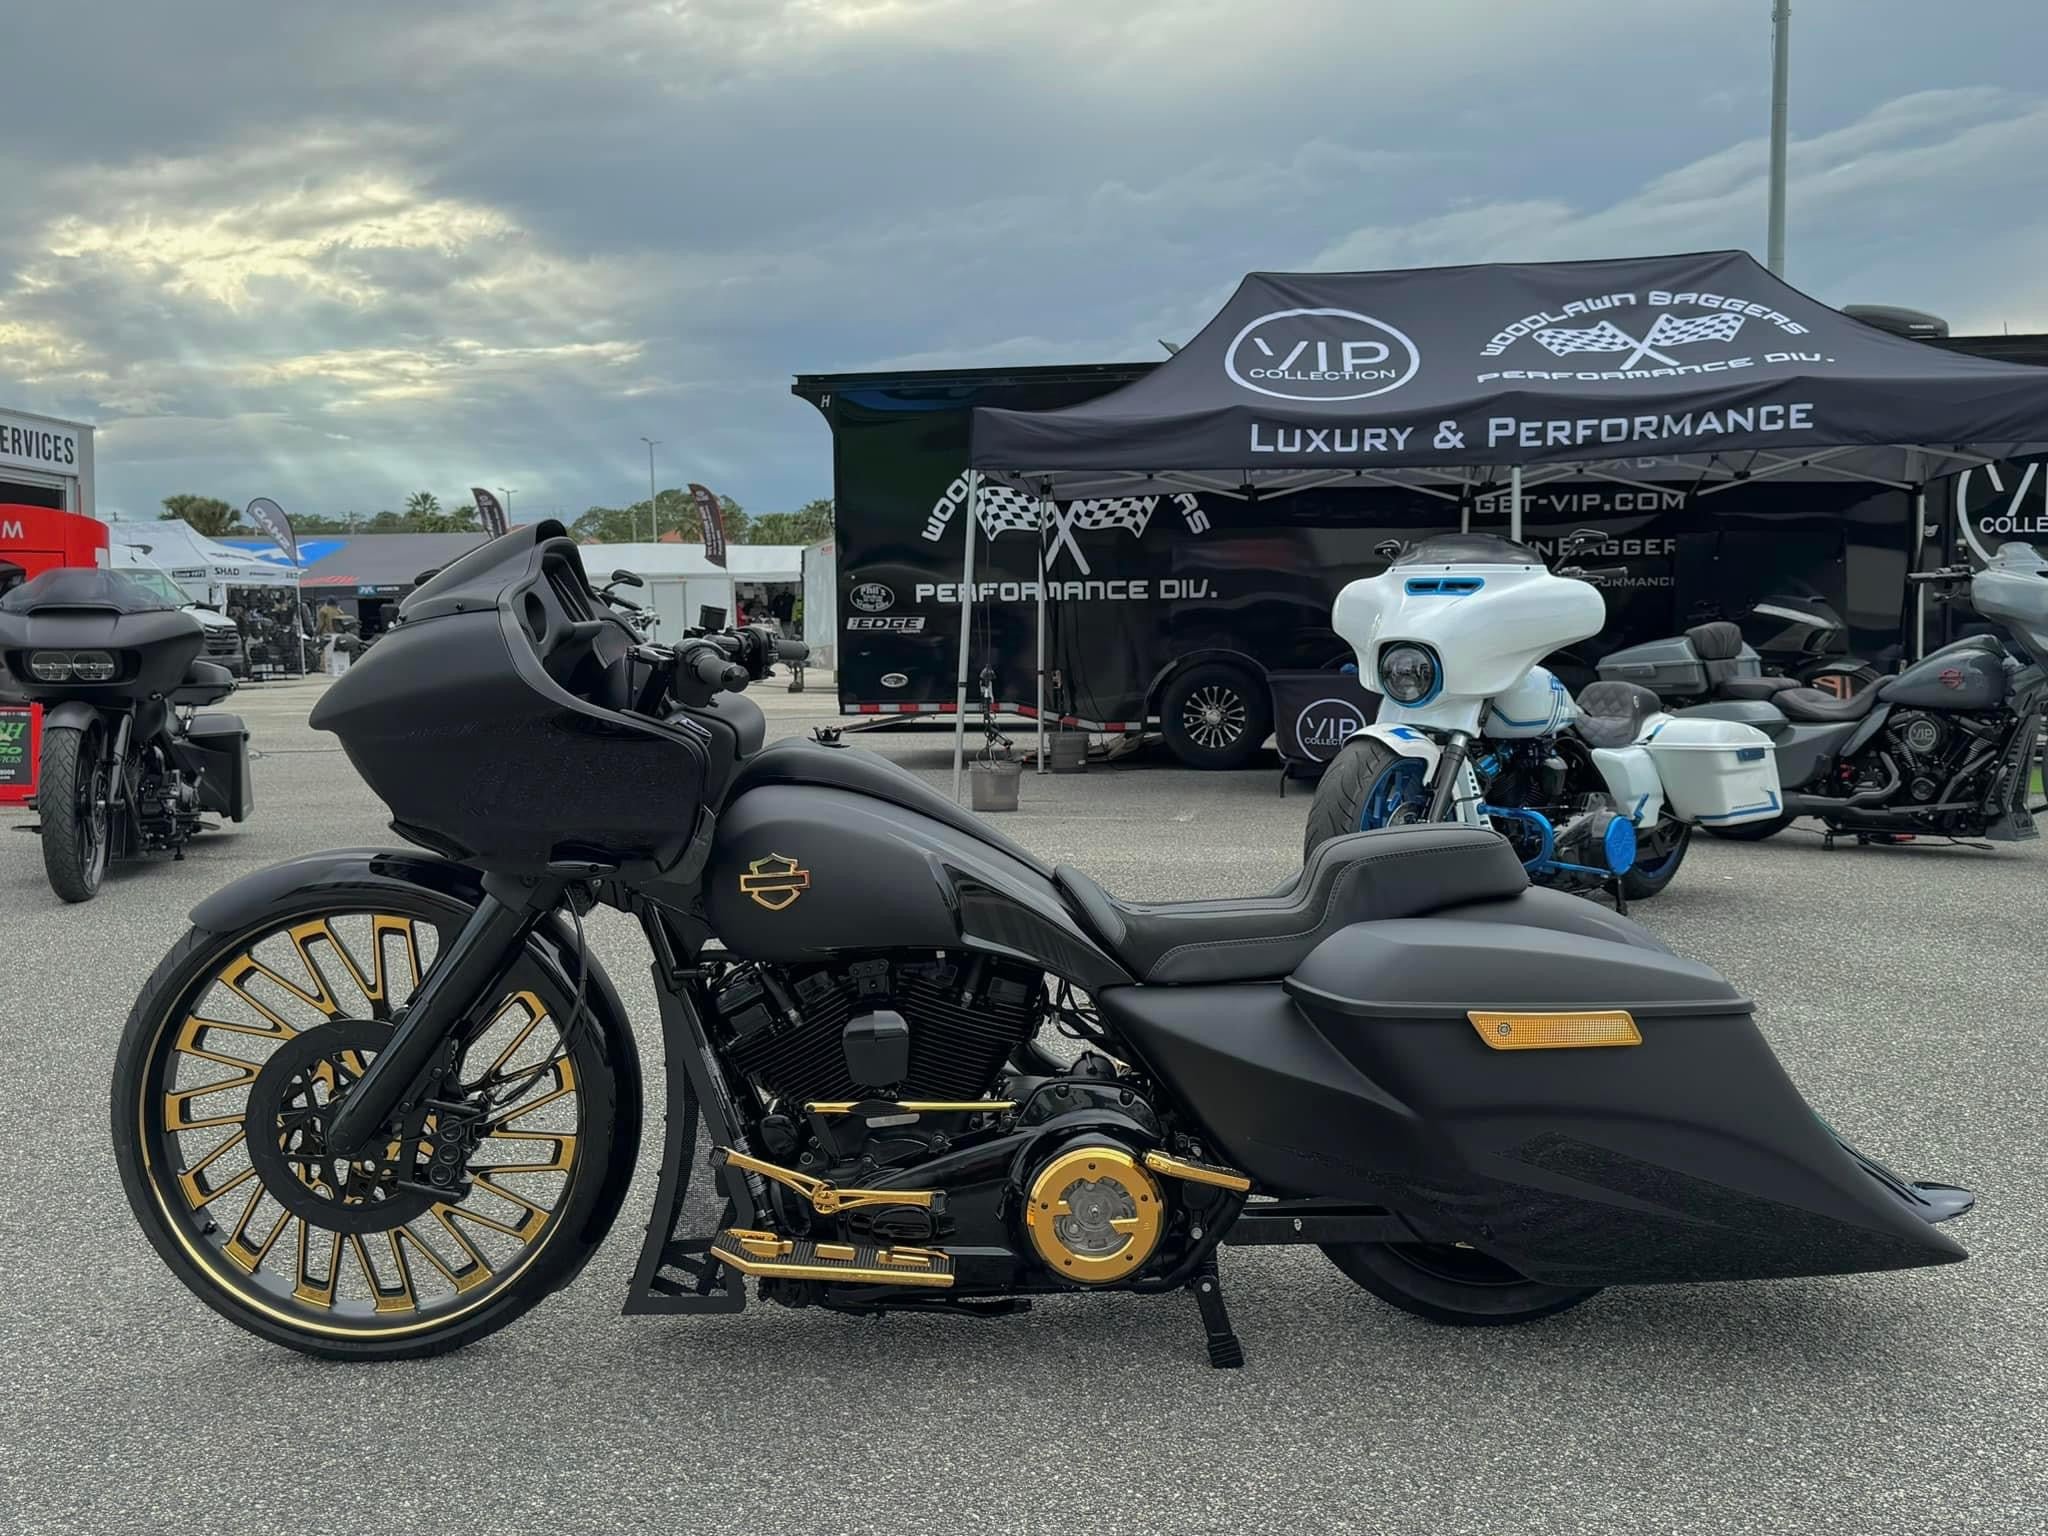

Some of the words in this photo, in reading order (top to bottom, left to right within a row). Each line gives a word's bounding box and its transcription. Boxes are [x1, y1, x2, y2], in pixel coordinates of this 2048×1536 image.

[1480, 293, 1637, 356] WOODLAWN
[1648, 291, 1810, 335] BAGGERS
[1253, 337, 1390, 372] VIP
[1250, 368, 1396, 381] COLLECTION
[1477, 357, 1754, 383] PERFORMANCE
[1764, 352, 1835, 363] DIV.
[1251, 423, 1414, 453] LUXURY
[1433, 420, 1465, 449] &
[1488, 403, 1814, 447] PERFORMANCE
[0, 425, 74, 464] ERVICES
[1474, 493, 1685, 514] GET-VIP.COM
[214, 567, 240, 577] SHAD
[915, 580, 1149, 603] PERFORMANCE
[1159, 579, 1217, 599] DIV.
[857, 618, 919, 628] EDGE
[1306, 717, 1358, 739] VIP
